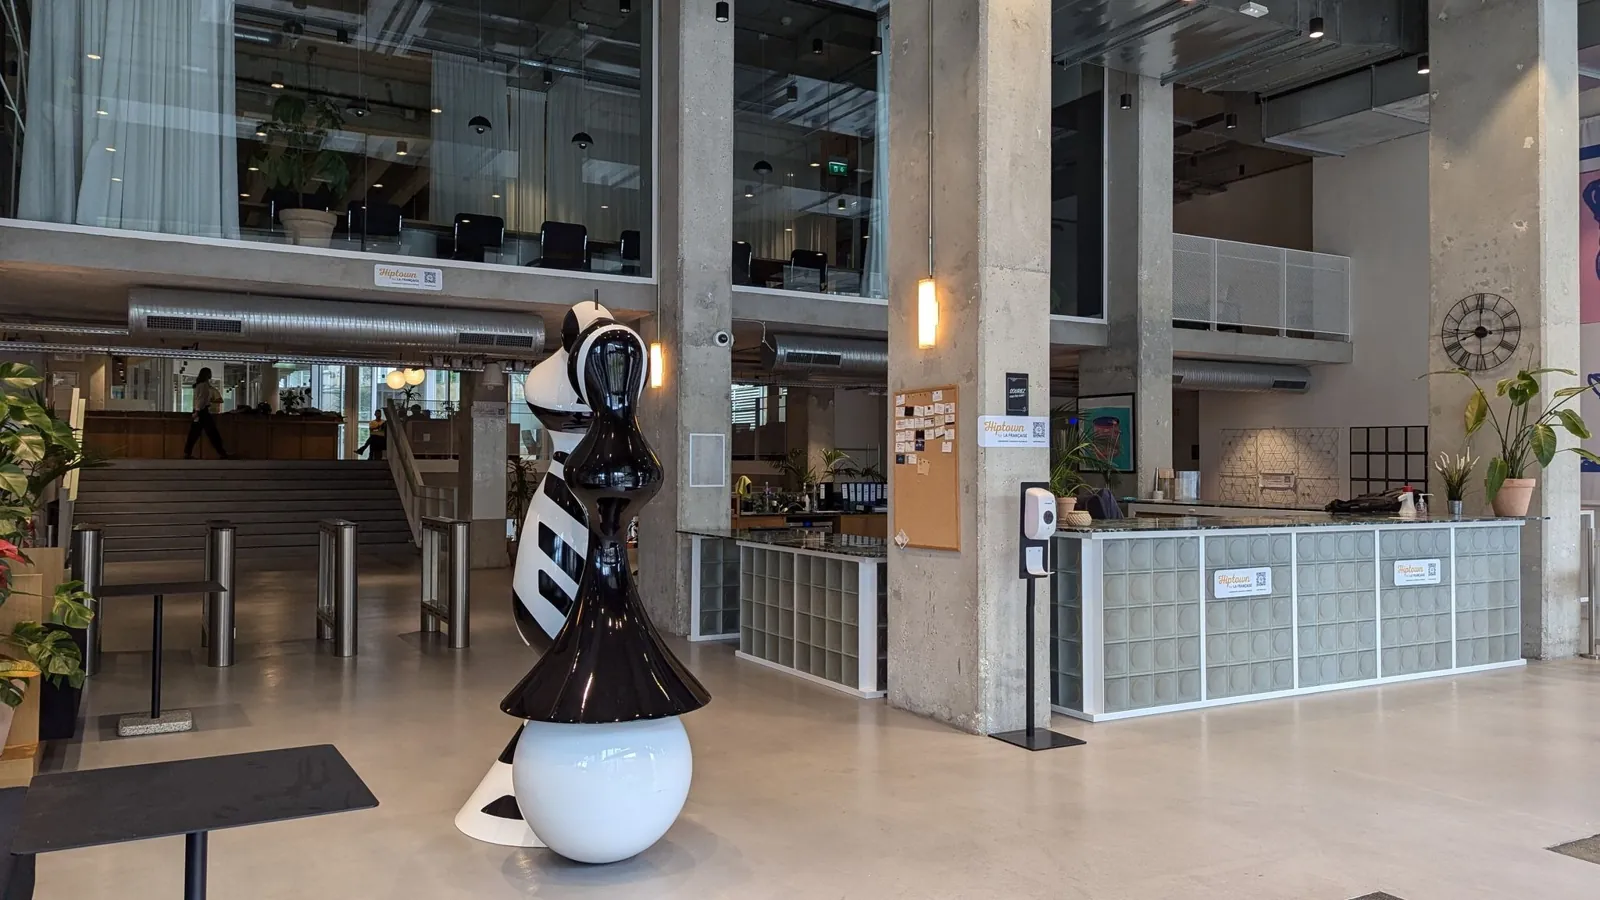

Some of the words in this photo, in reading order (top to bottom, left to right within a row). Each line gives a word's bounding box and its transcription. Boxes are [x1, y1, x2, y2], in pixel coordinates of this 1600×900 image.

[379, 268, 417, 279] Hiptown
[984, 421, 1025, 436] Hiptown
[1218, 573, 1250, 588] Hiptown
